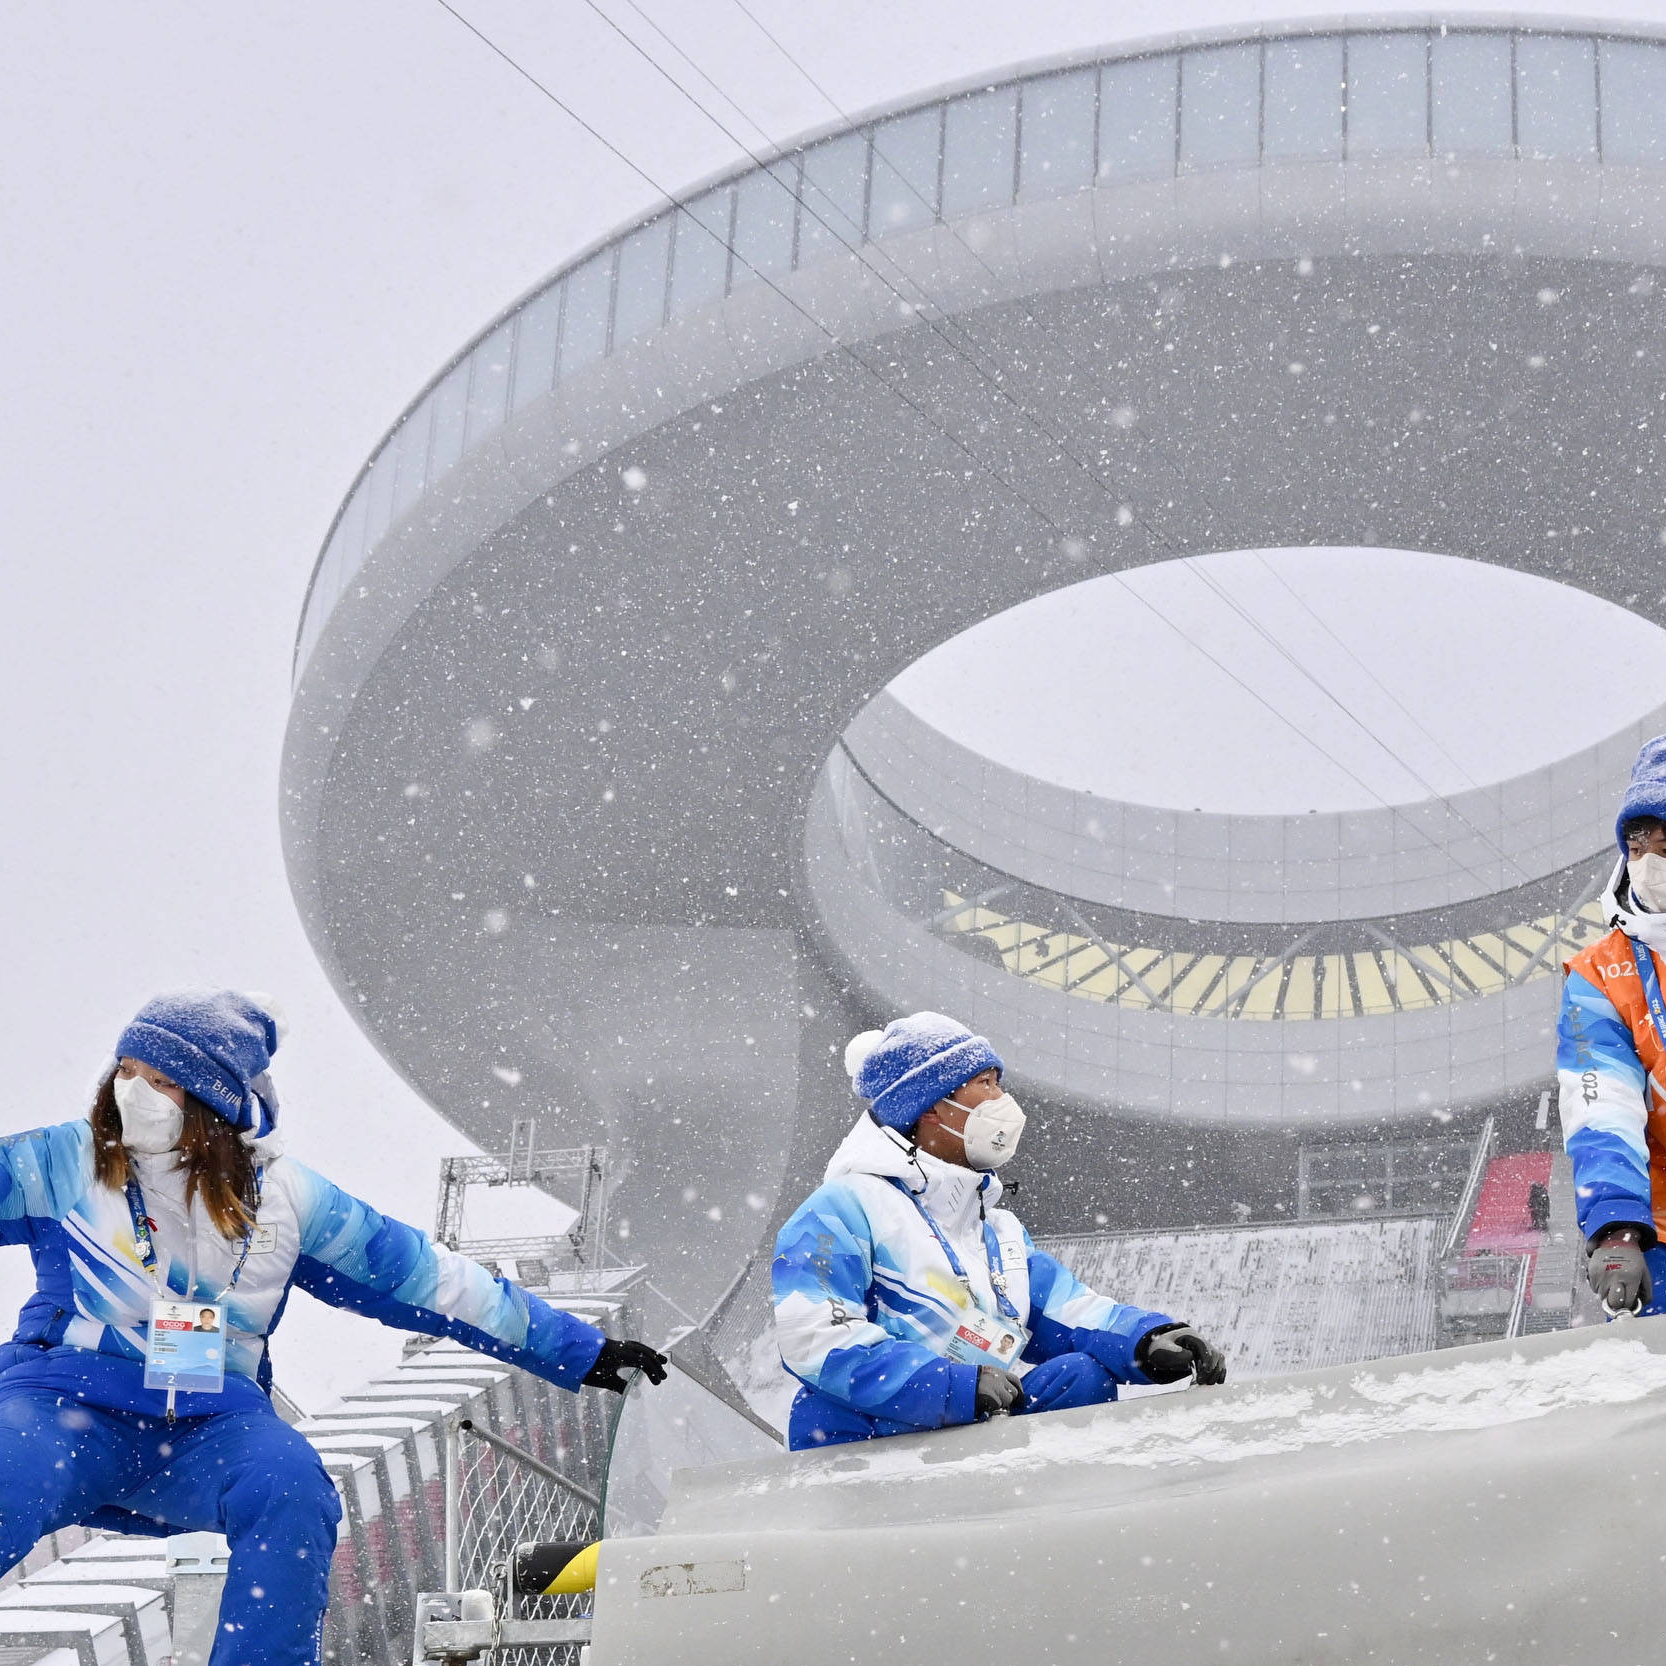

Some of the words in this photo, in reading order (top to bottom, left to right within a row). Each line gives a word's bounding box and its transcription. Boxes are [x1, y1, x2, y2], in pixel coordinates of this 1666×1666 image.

[1597, 961, 1640, 980] 102
[162, 1320, 186, 1328] OCOG
[167, 1375, 175, 1384] 2
